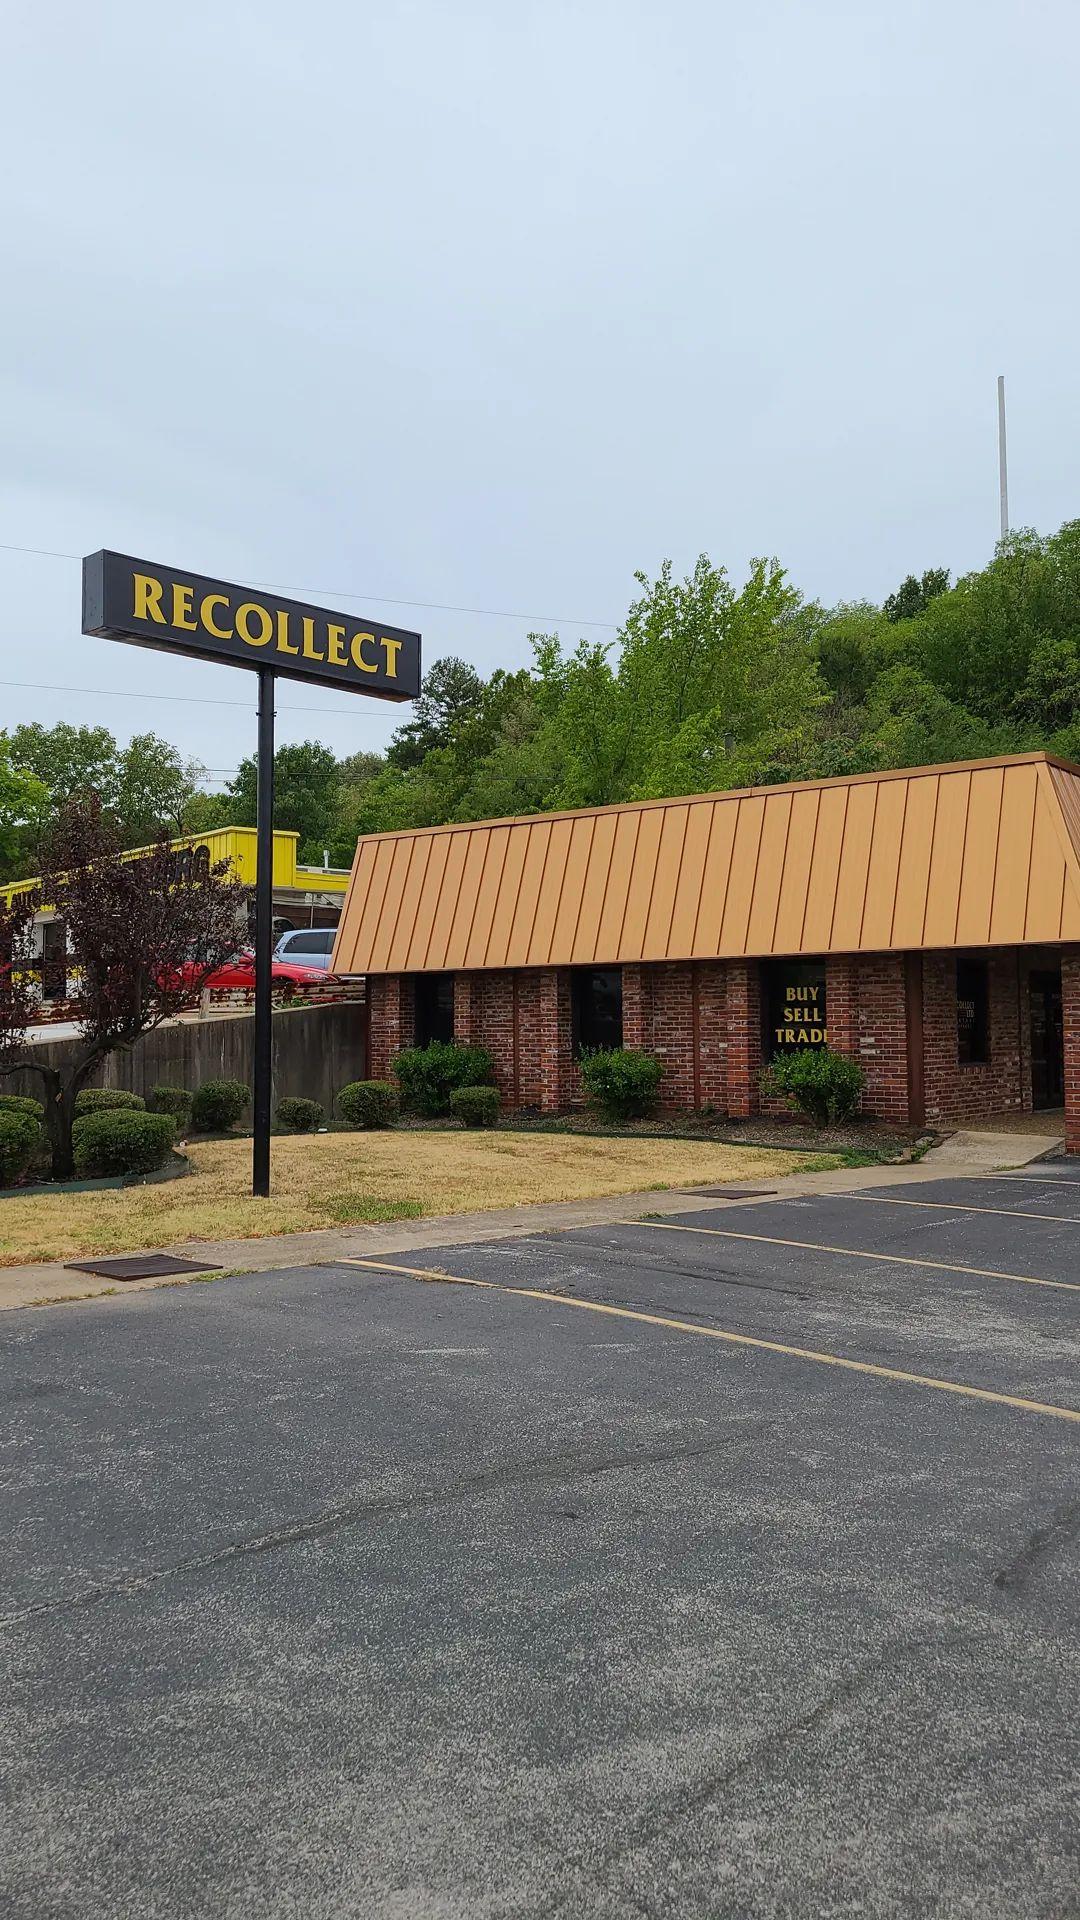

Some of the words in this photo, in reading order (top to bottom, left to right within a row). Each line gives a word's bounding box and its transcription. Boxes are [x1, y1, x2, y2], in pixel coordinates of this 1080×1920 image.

[132, 572, 403, 678] RECOLLECT
[786, 986, 819, 1001] BUY
[783, 1007, 822, 1022] SELL
